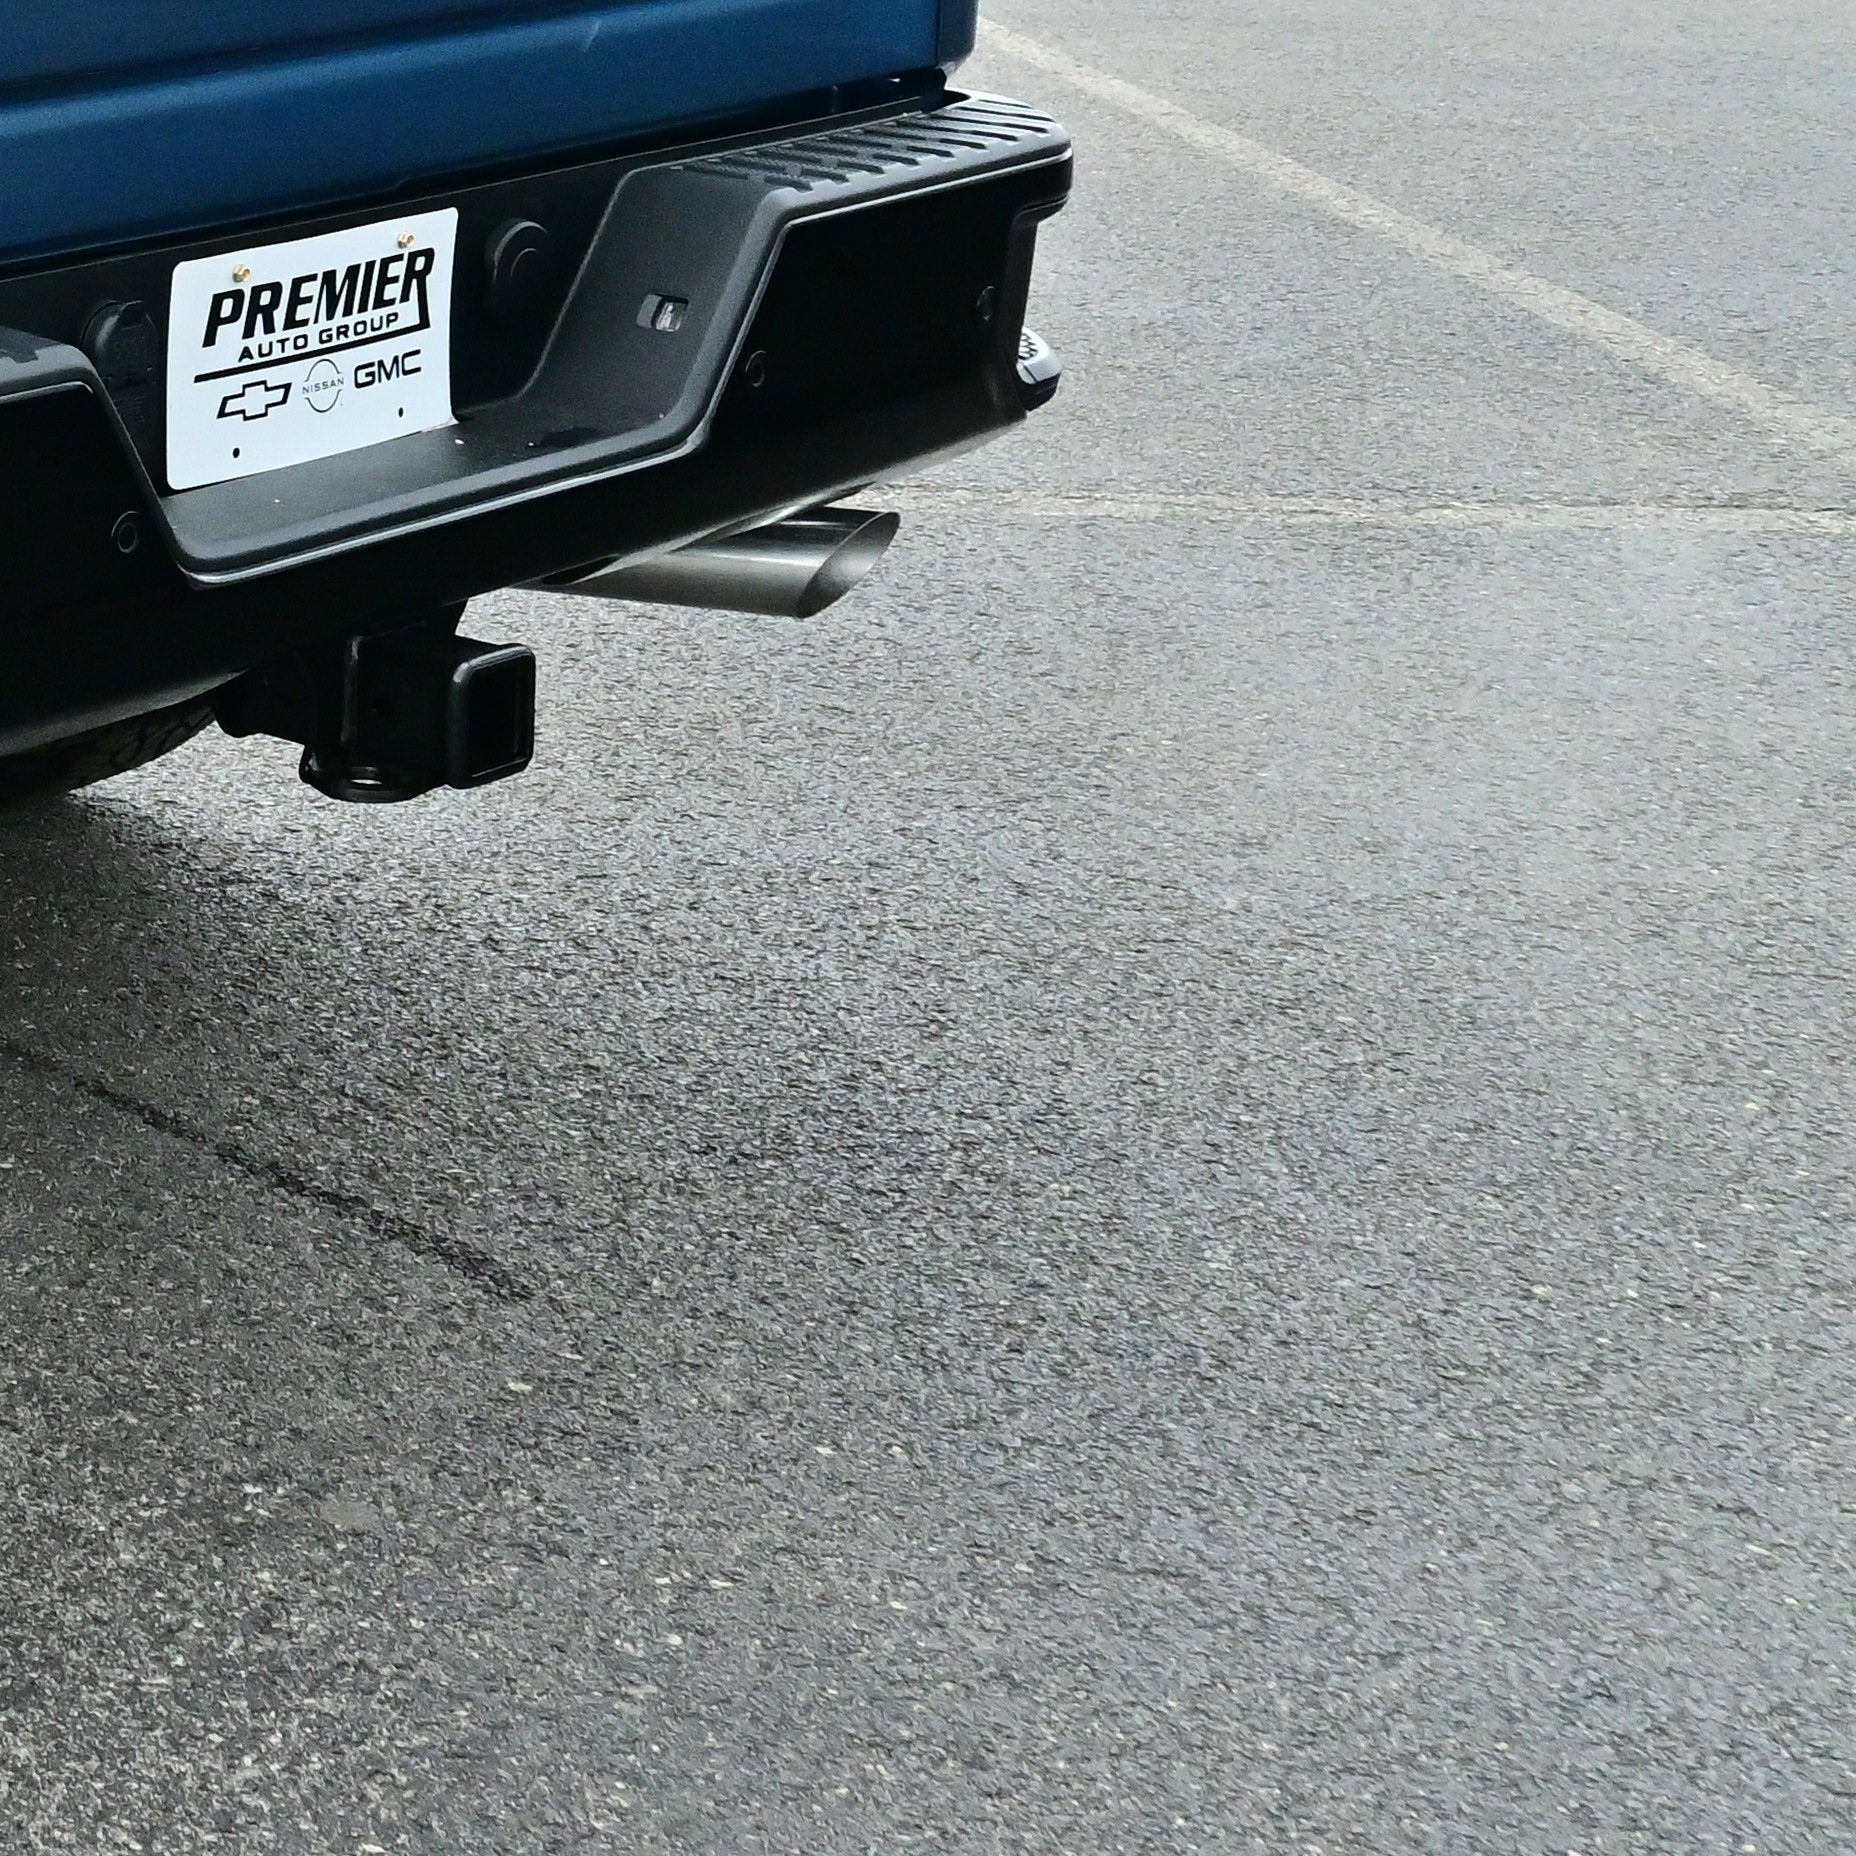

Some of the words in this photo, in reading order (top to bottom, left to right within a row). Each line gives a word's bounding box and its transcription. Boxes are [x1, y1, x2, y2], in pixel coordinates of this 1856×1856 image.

[202, 247, 435, 349] PREMIER
[238, 334, 308, 363] AUTO
[318, 311, 399, 345] GROUP
[302, 376, 345, 395] NISSAN
[354, 348, 422, 389] GMC
